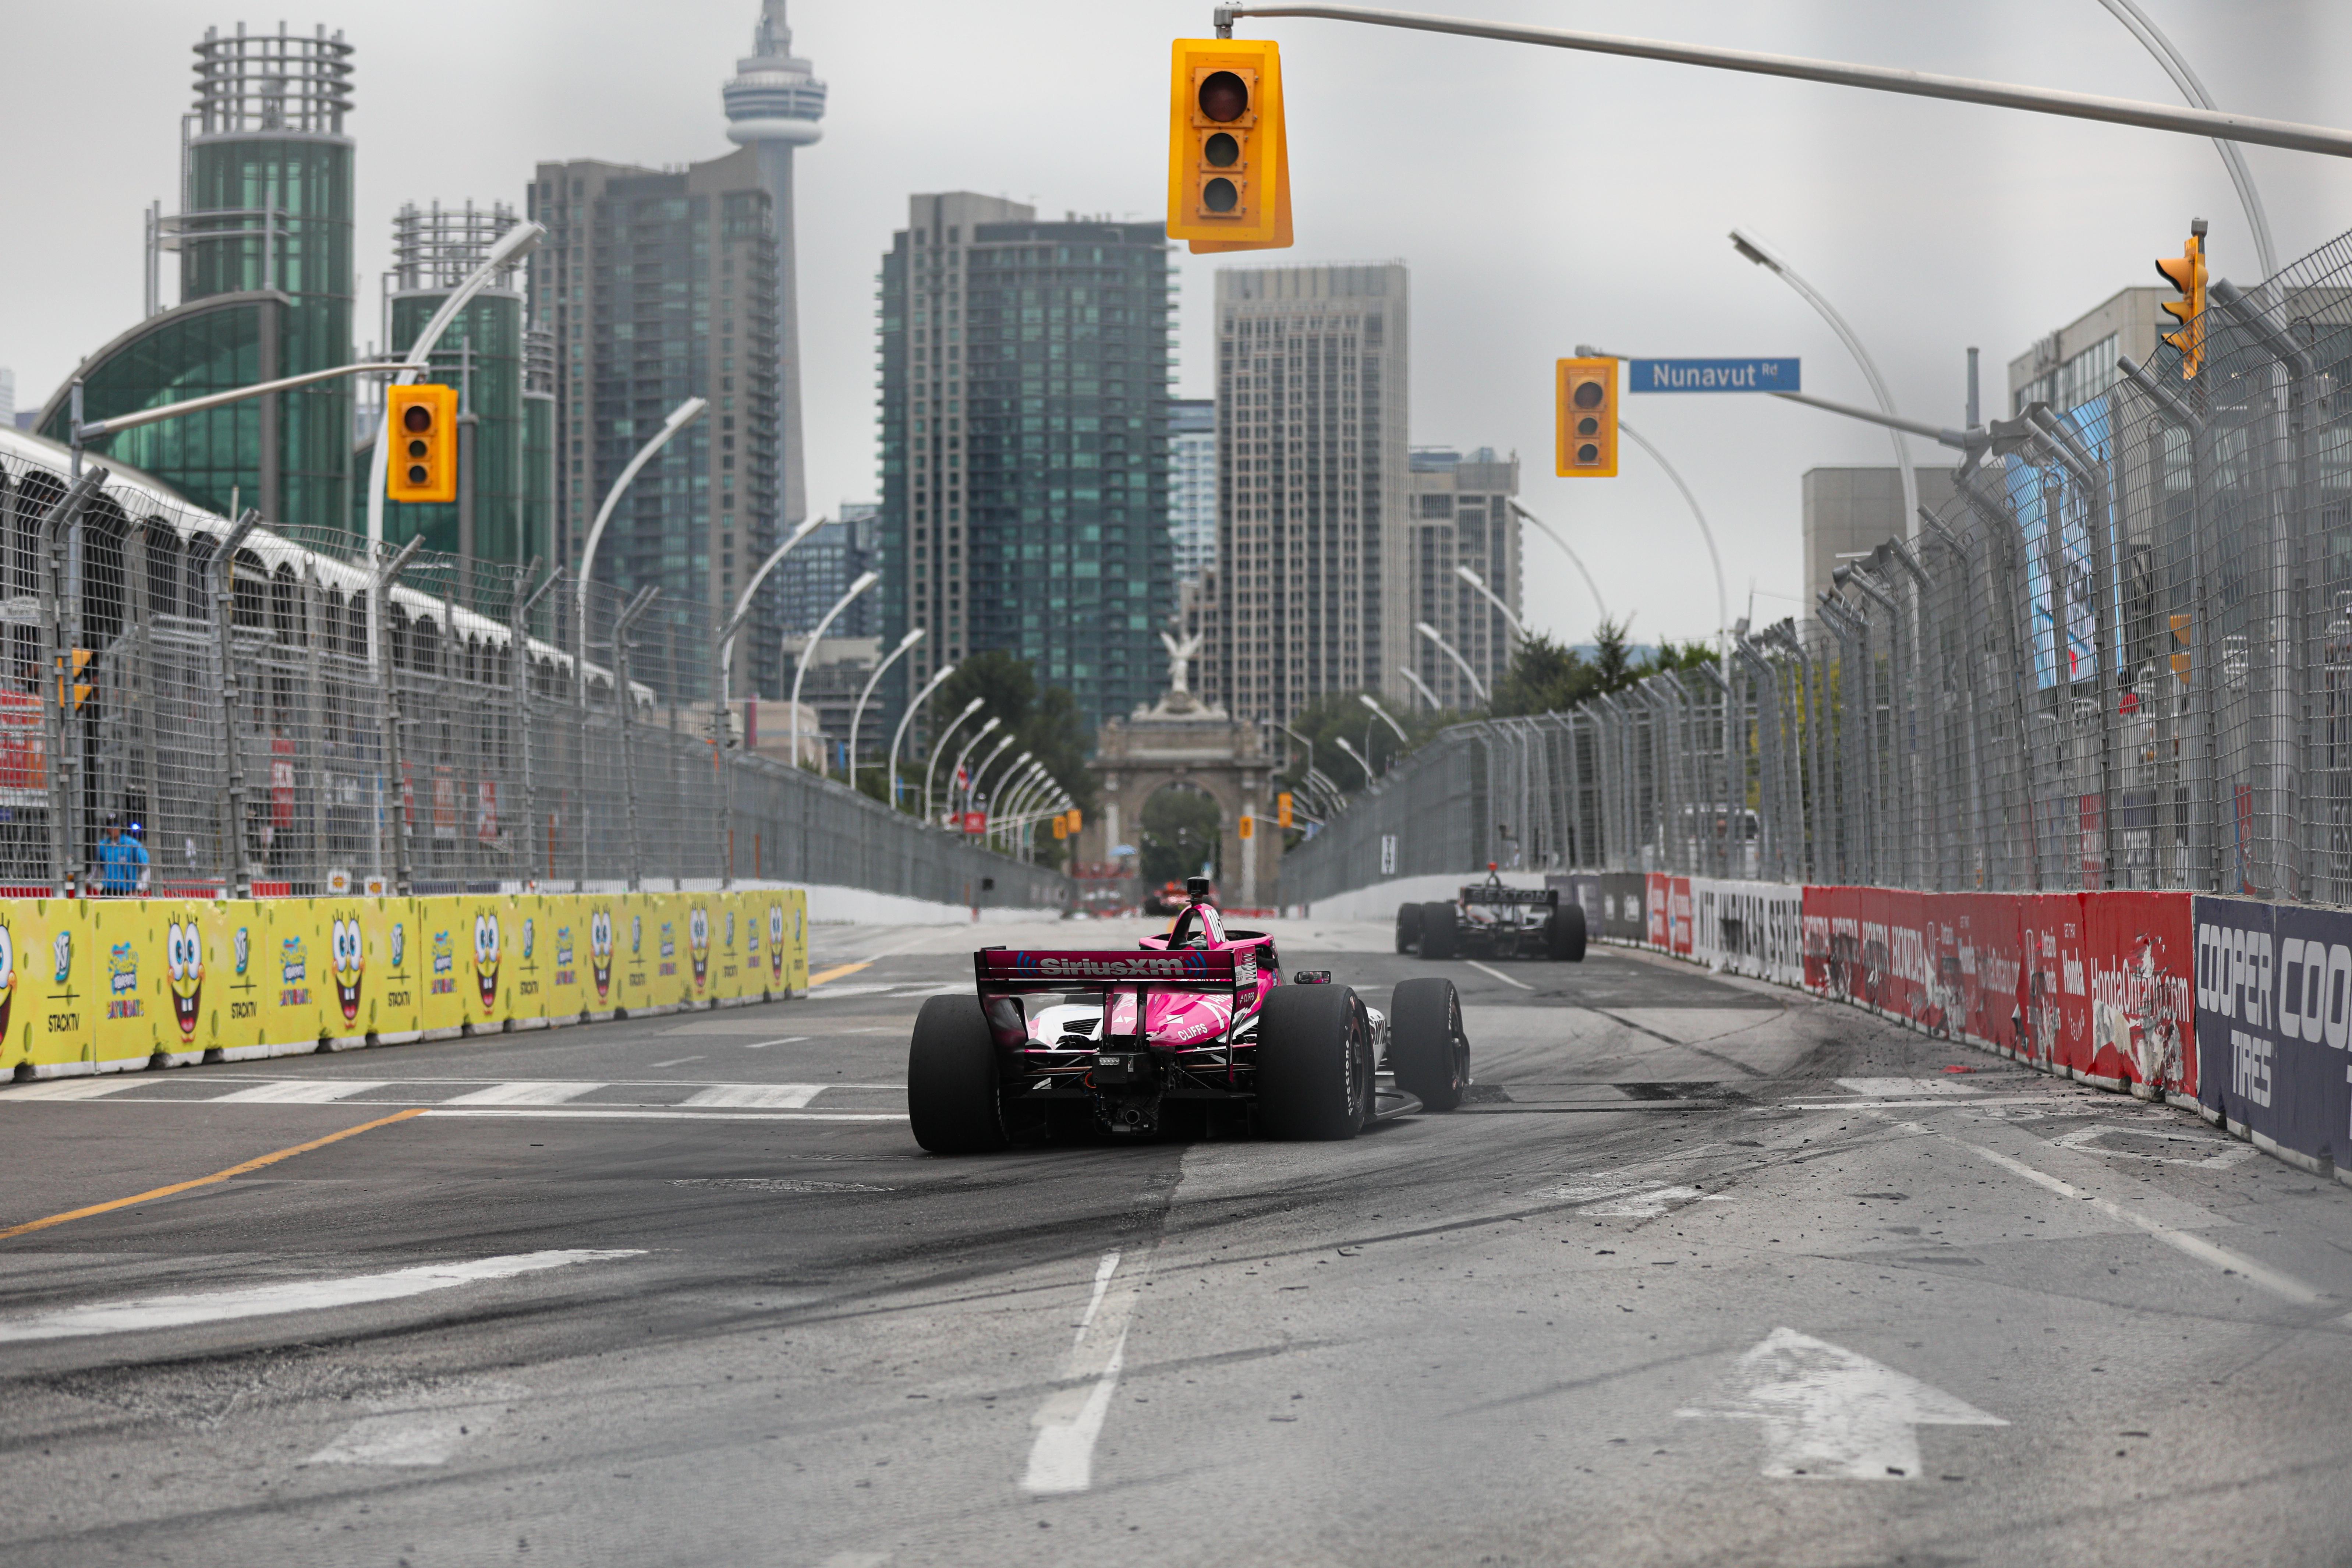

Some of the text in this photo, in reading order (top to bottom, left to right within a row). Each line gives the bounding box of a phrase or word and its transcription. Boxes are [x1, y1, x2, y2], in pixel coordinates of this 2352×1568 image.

[1653, 362, 1778, 387] Nunavut Rd
[1204, 908, 1226, 943] 06
[1892, 926, 1925, 985] HONDA
[2042, 926, 2056, 958] Ontario
[2062, 947, 2085, 997] Honda
[2198, 923, 2352, 1052] COOPER COO
[388, 991, 411, 1007] STACKTV
[1244, 992, 1255, 1003] CLIFFS
[2090, 954, 2189, 1023] HondaOntario.com
[48, 1013, 80, 1033] STACKTV
[107, 999, 145, 1019] SATURDAYS
[231, 1001, 257, 1019] STACKTV
[2068, 1008, 2084, 1041] FEELING
[1177, 1023, 1208, 1041] CLIFFS
[1345, 1039, 1353, 1116] Firestone
[2231, 1029, 2272, 1108] TIRES
